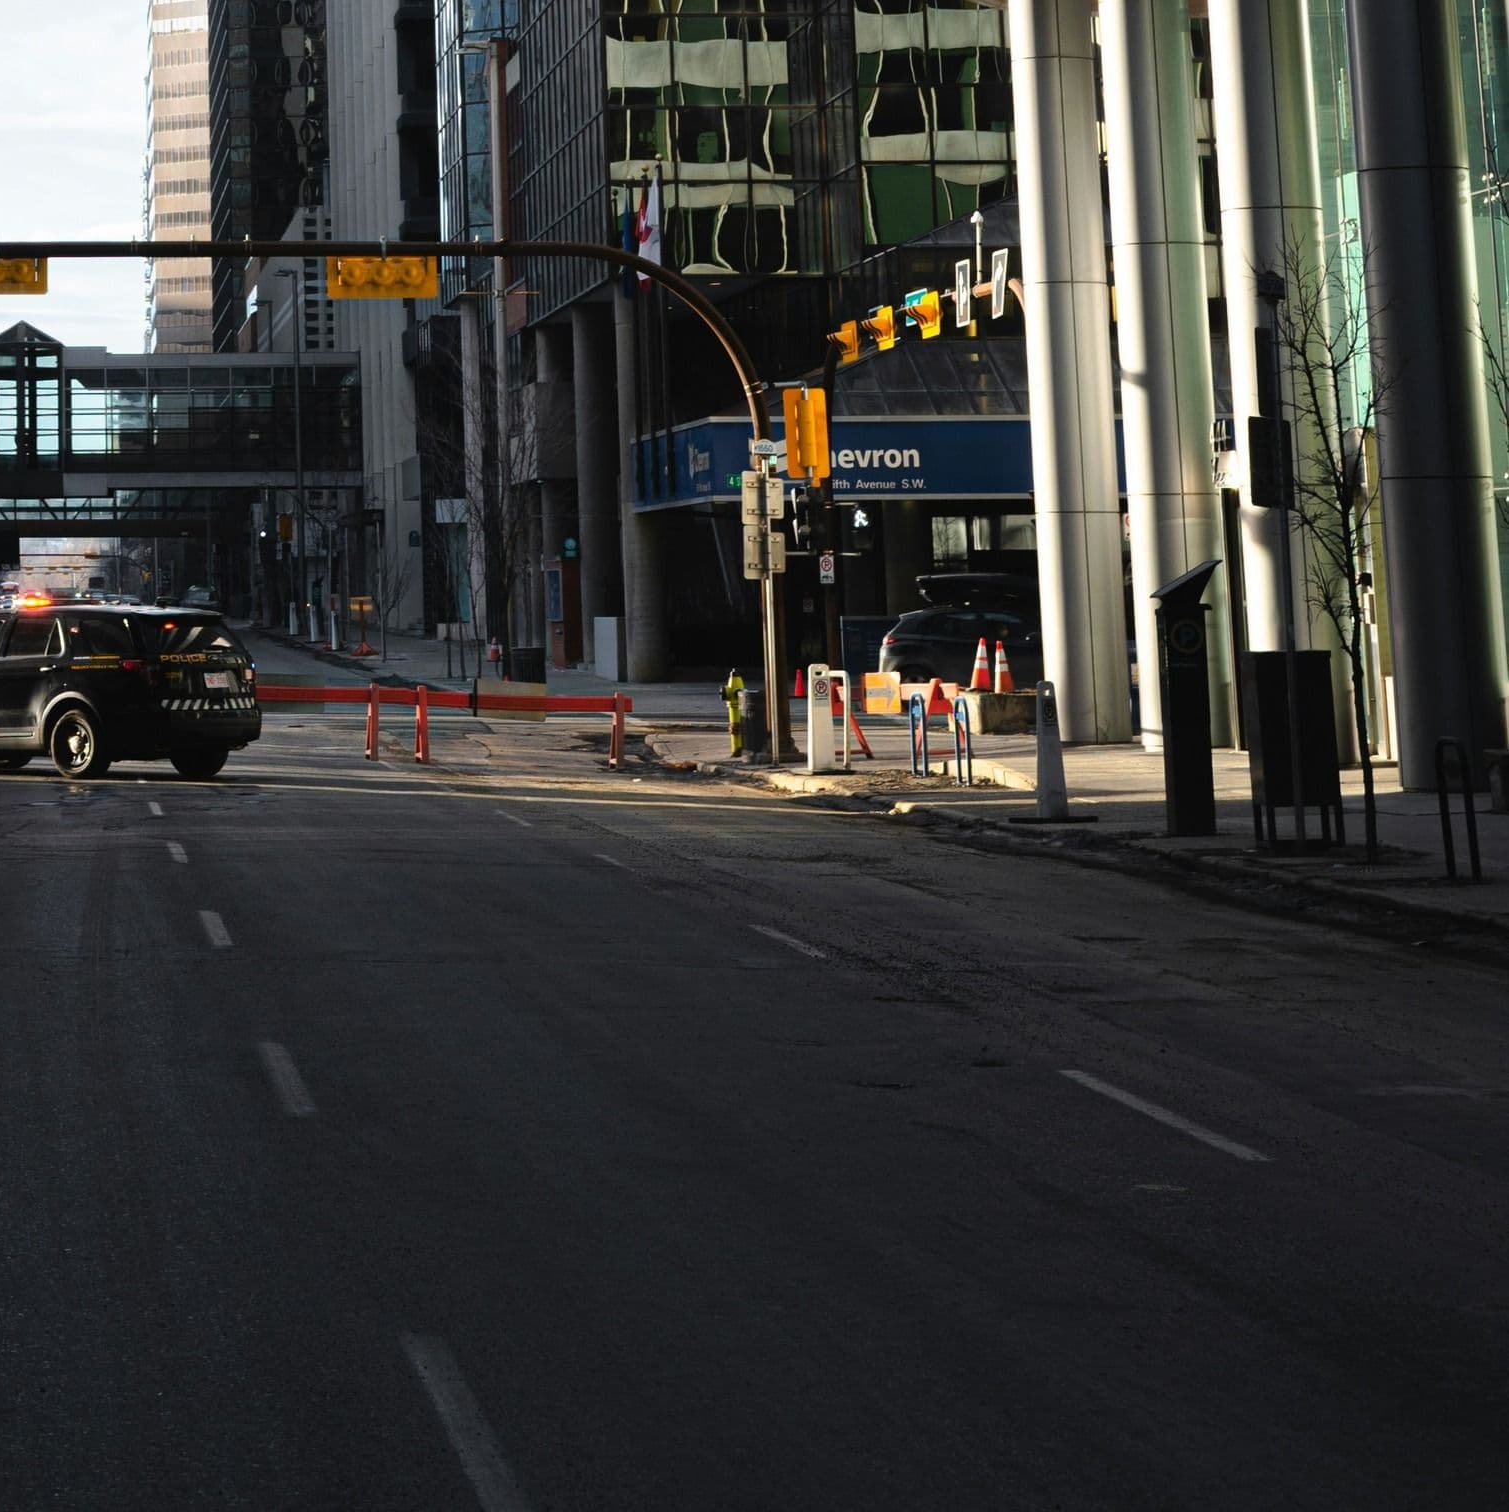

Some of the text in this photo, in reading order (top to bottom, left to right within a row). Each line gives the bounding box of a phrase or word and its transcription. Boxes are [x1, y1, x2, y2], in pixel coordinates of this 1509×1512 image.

[831, 448, 920, 469] evron
[832, 478, 926, 489] ifth Avenue S.W.
[160, 653, 207, 663] POLICE
